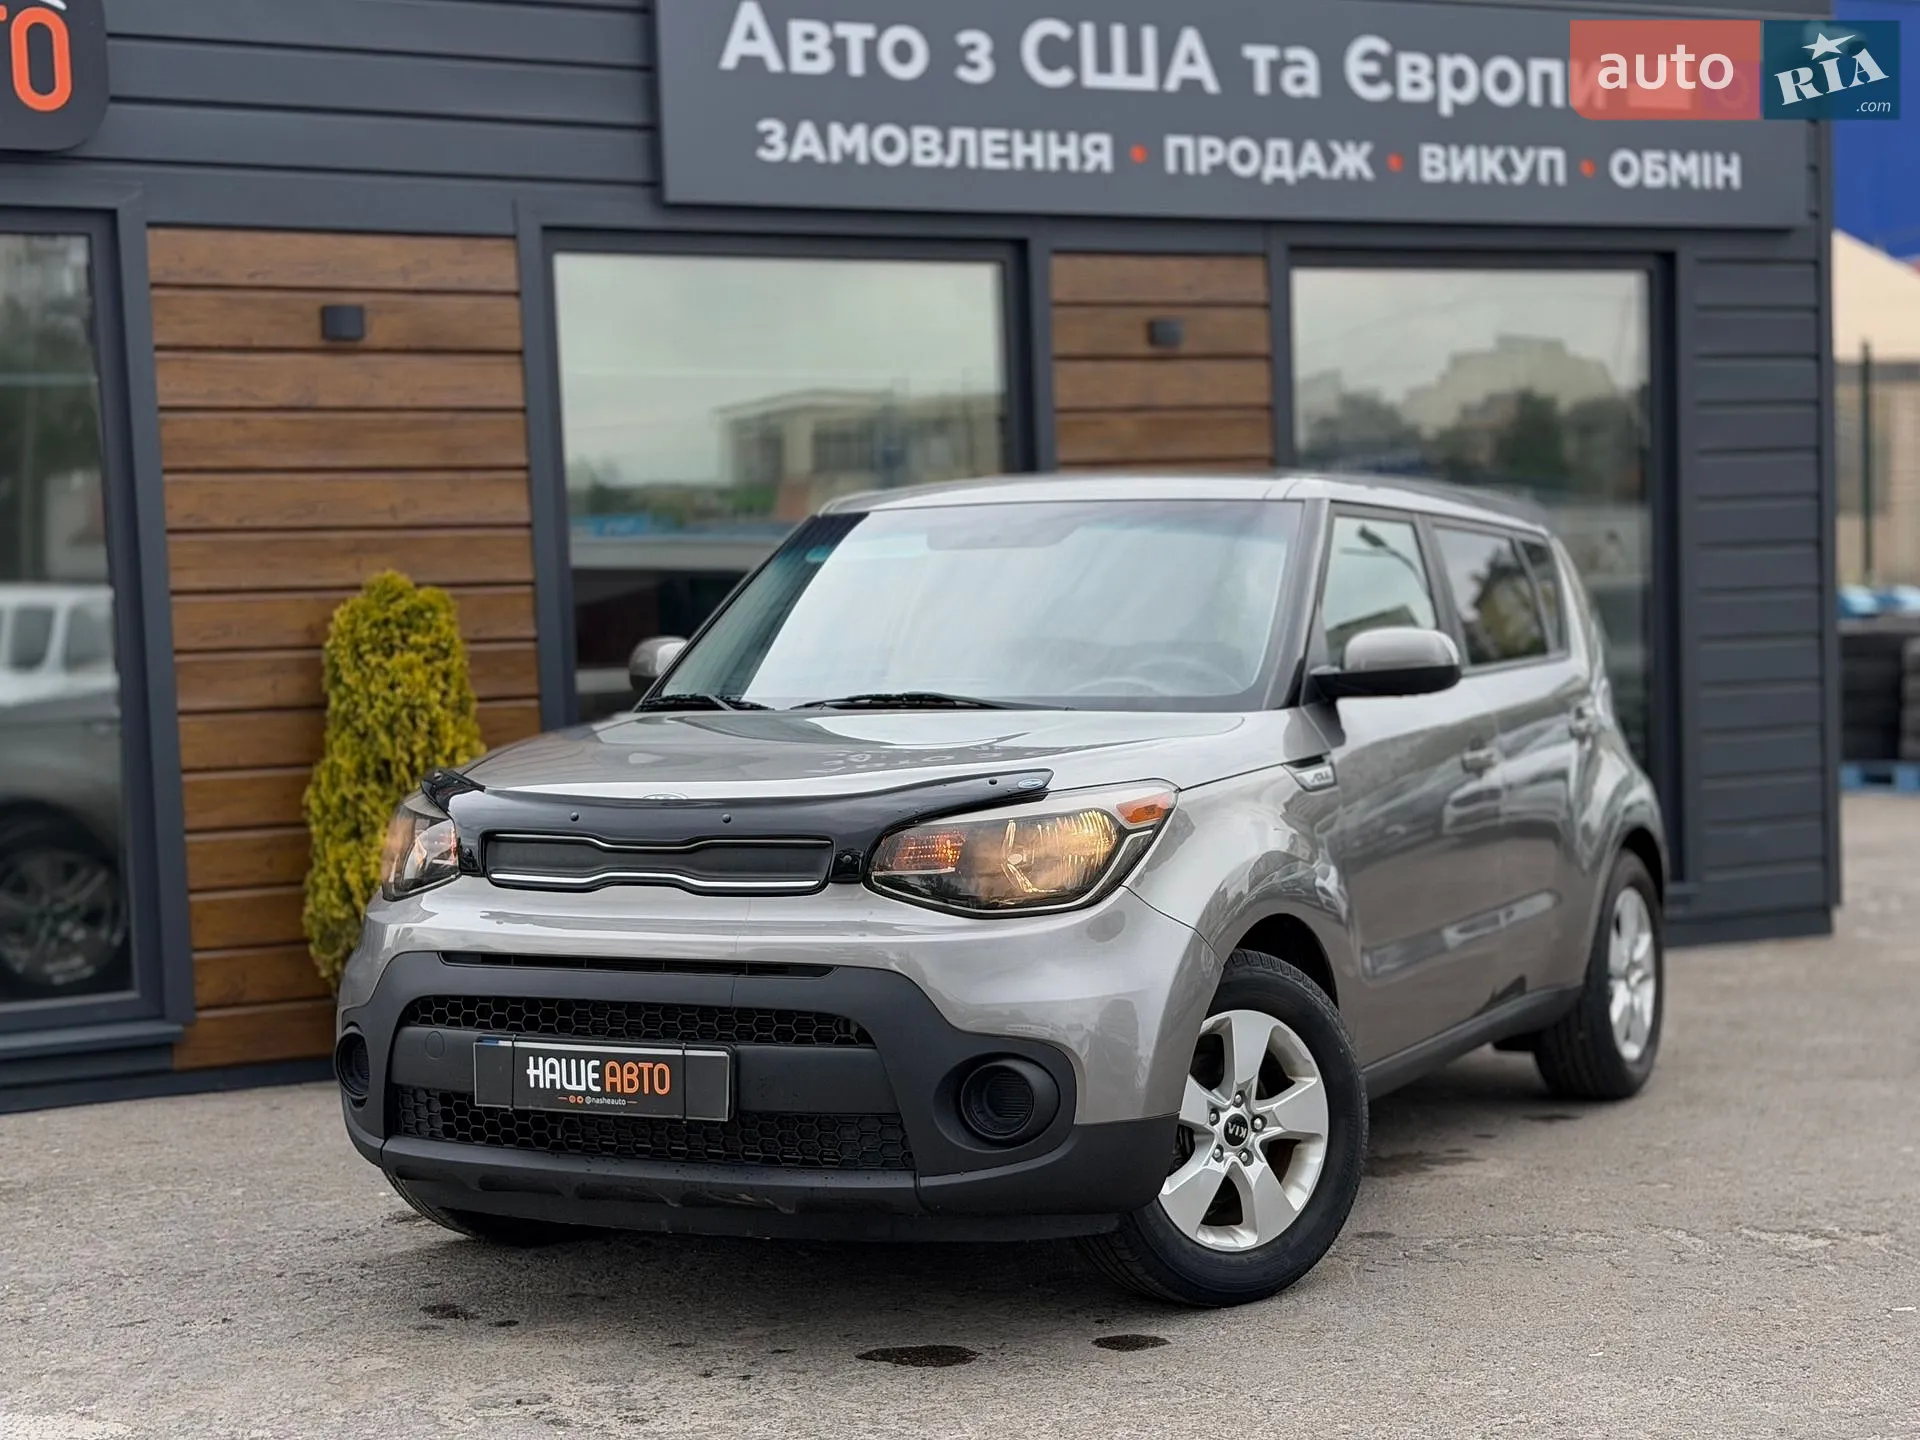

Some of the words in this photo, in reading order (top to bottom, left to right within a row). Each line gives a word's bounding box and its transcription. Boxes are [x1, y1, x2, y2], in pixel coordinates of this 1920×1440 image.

[719, 0, 930, 81] Авто
[1020, 18, 1221, 95] США
[1241, 43, 1322, 98] та
[755, 118, 1114, 173] ЗАМОВЛЕННЯ
[1163, 134, 1376, 185] ПРОДАЖ
[1418, 143, 1568, 186] ВИКУП
[1609, 149, 1742, 190] ОБМІН
[526, 1056, 601, 1092] НАШЕ
[605, 1061, 670, 1095] АВТО
